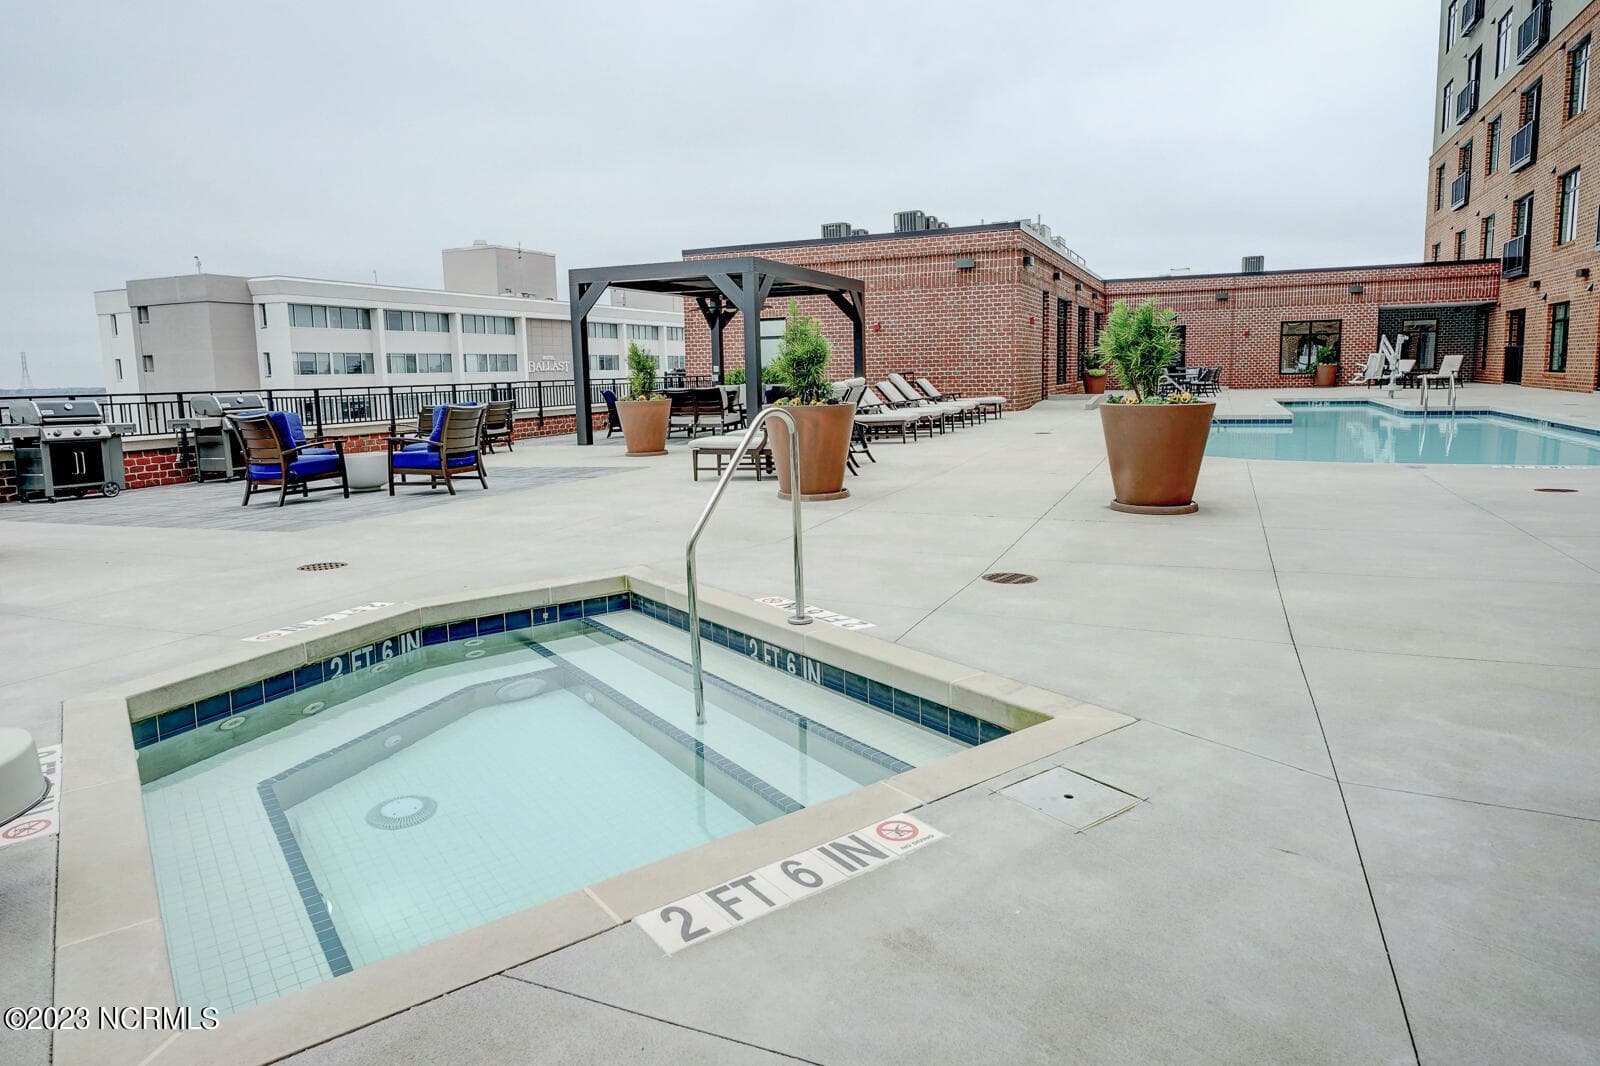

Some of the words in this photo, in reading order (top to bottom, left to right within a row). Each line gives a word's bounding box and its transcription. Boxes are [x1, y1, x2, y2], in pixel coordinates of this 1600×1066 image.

[528, 361, 569, 373] BALLAST
[330, 657, 344, 680] 2
[351, 644, 374, 673] FT
[382, 640, 394, 661] 6
[400, 630, 420, 654] IN
[749, 639, 758, 660] 2
[764, 645, 780, 668] FT
[786, 653, 796, 674] 6
[803, 657, 821, 684] IN
[660, 906, 711, 943] 2
[705, 875, 776, 921] FT
[780, 860, 824, 888] 6
[816, 834, 890, 872] IN
